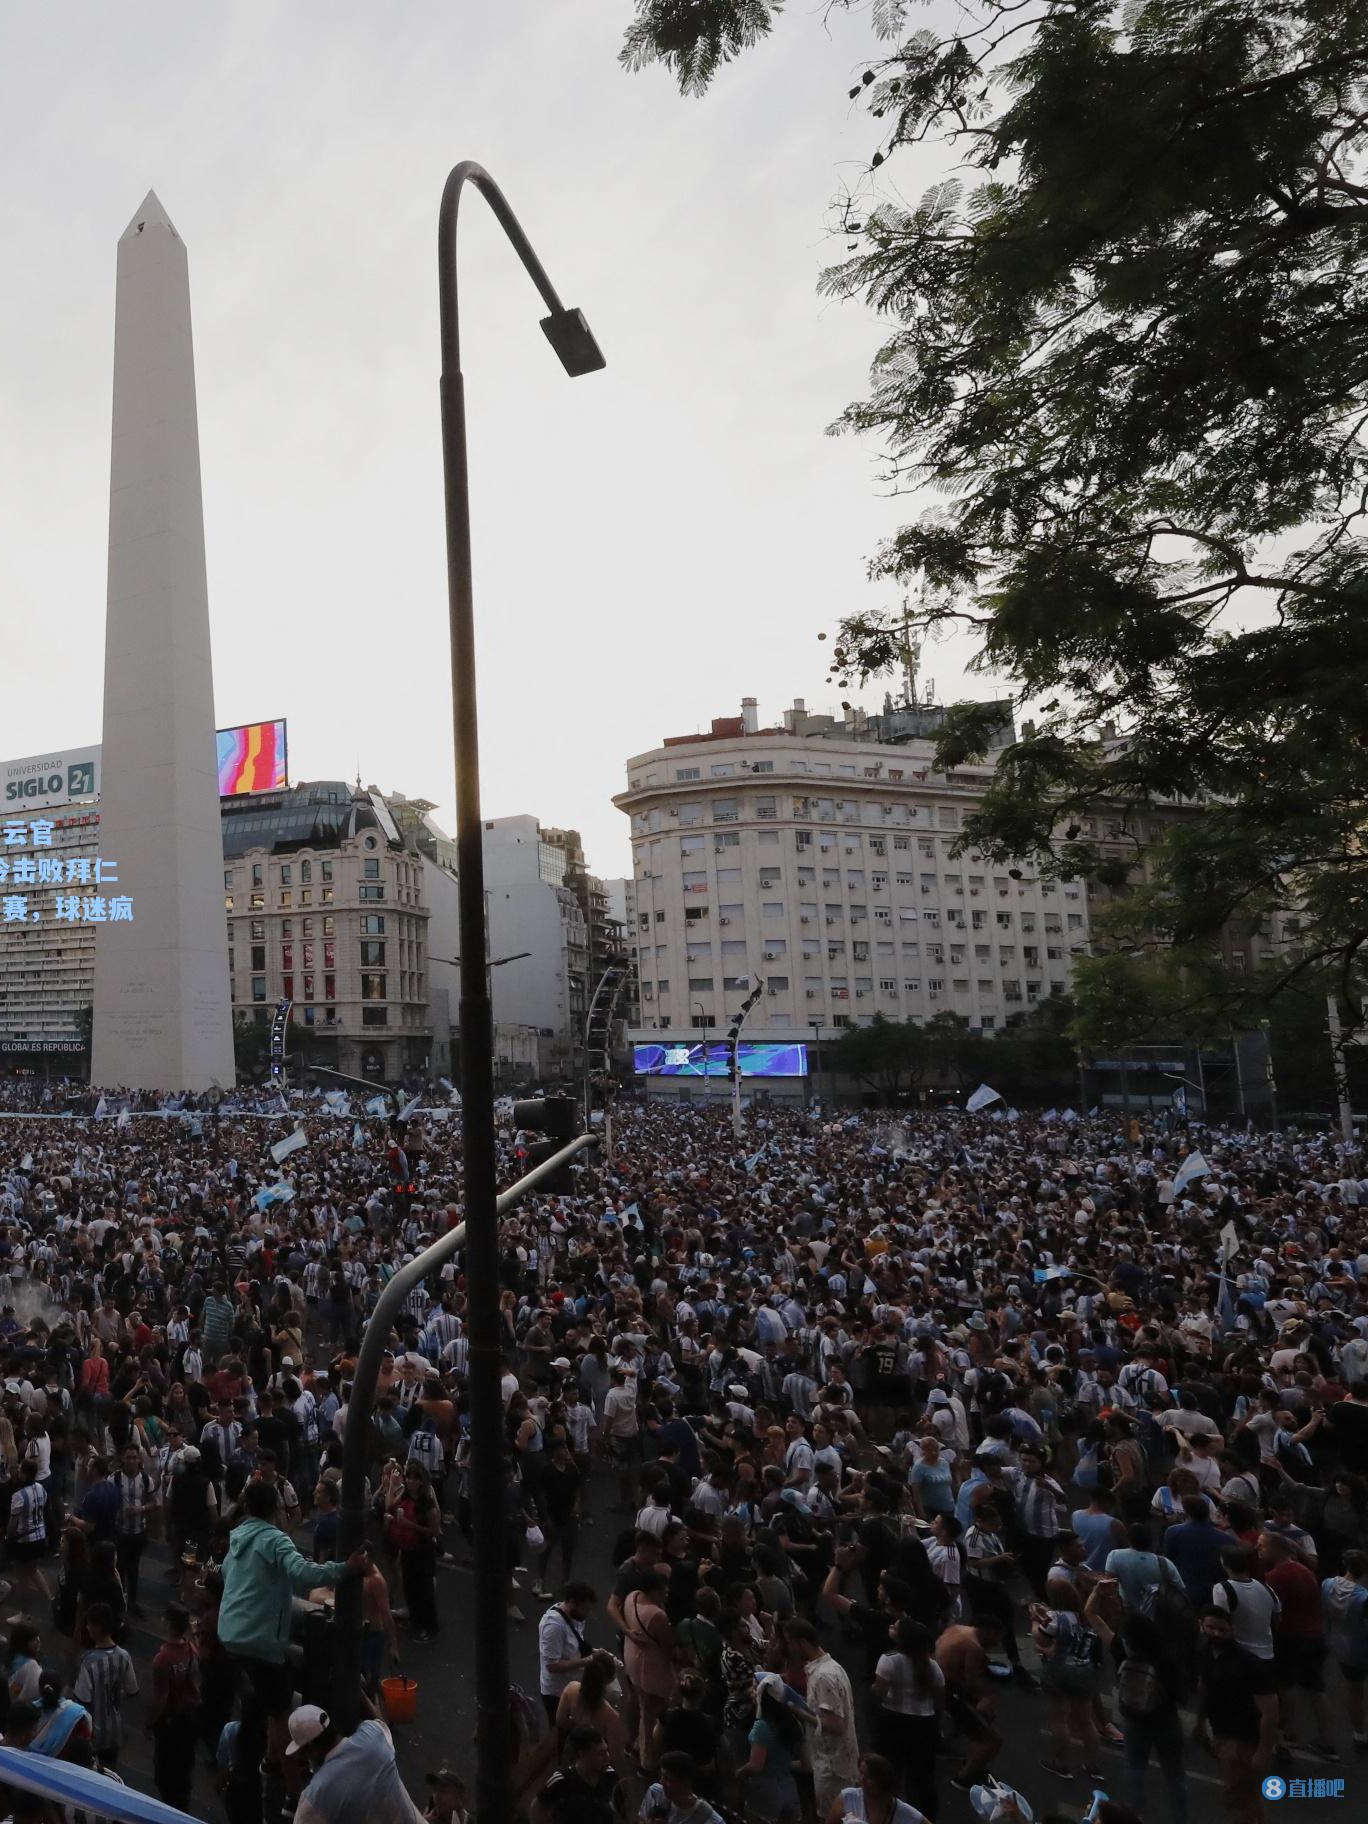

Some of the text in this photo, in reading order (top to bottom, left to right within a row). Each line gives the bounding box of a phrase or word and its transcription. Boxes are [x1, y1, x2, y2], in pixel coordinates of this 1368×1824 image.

[7, 759, 63, 777] UNIVERSIDAD
[6, 769, 91, 800] SIGLO 21
[410, 1295, 423, 1308] 10
[878, 1357, 894, 1374] 19
